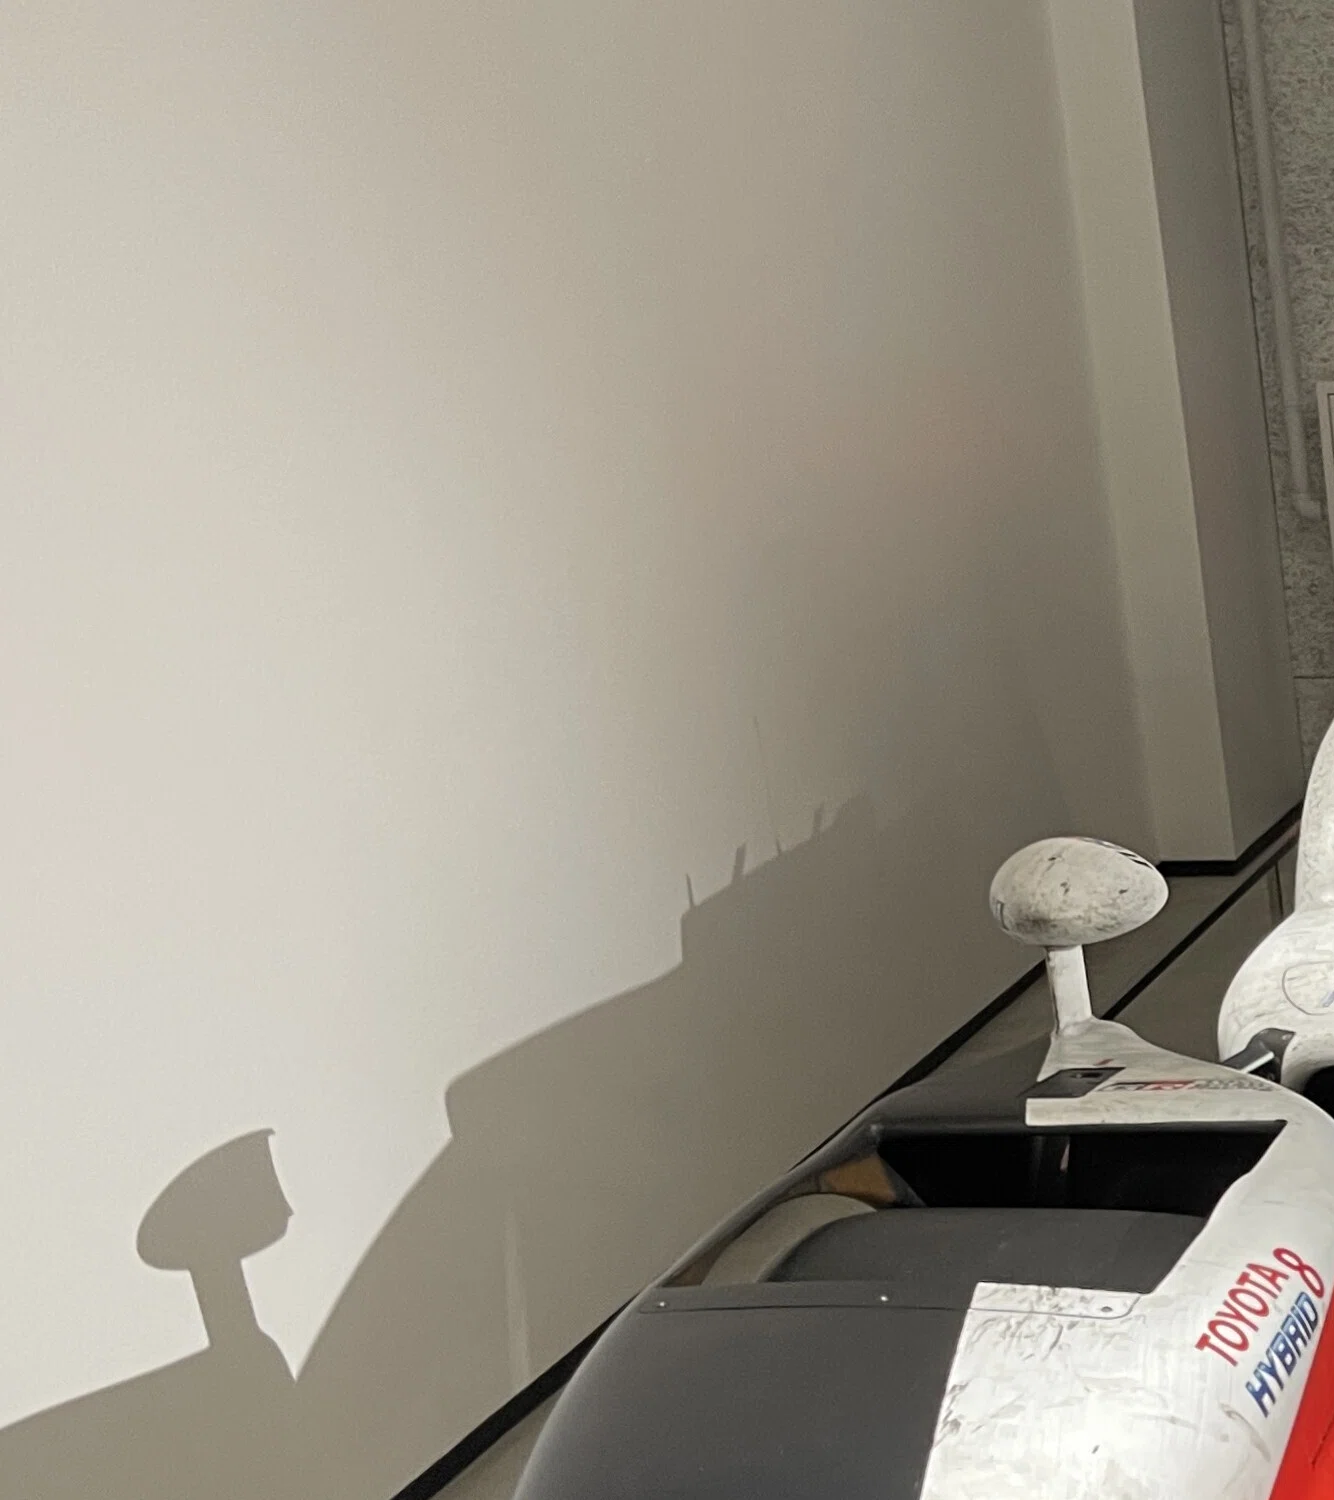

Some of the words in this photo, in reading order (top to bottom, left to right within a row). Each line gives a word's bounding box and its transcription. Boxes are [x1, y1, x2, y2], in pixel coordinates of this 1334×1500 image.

[1195, 1262, 1290, 1367] TOYOTA
[1273, 1246, 1325, 1299] 8
[1245, 1291, 1319, 1417] HYBRID
